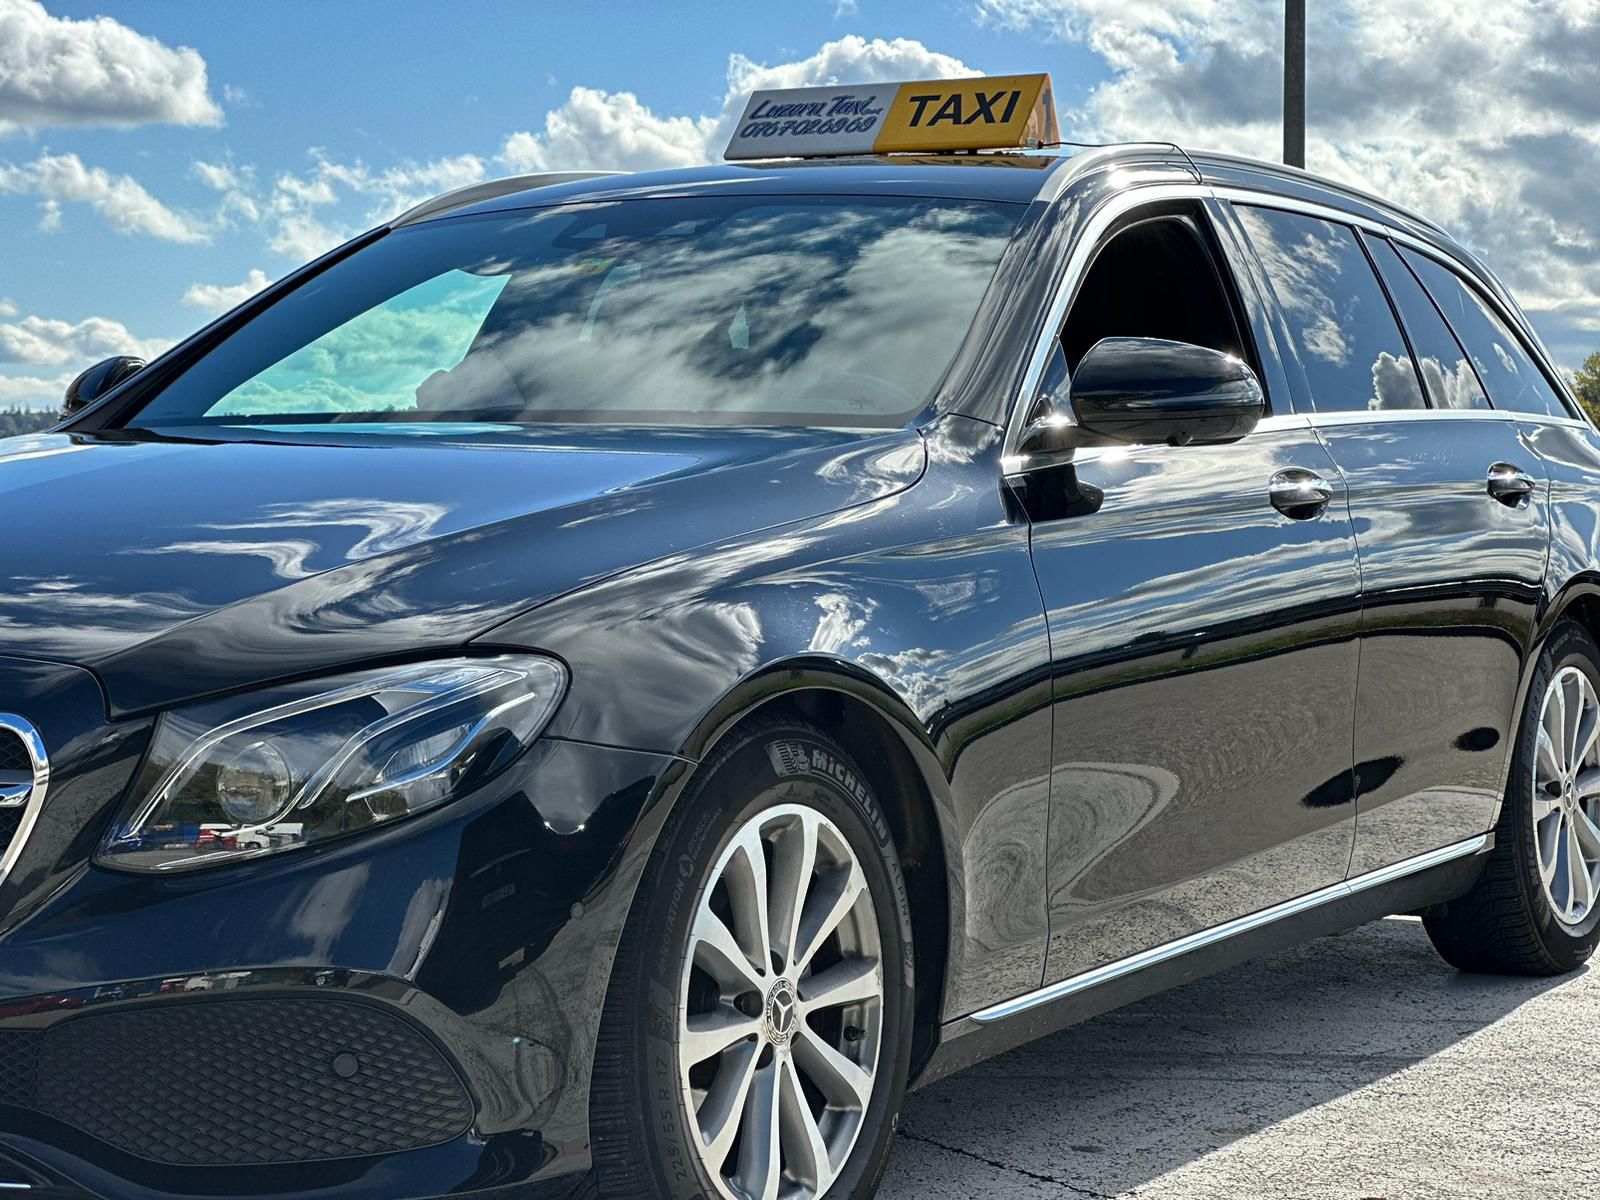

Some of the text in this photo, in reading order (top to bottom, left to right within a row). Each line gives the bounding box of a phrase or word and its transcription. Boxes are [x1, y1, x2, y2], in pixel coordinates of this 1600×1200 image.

[826, 95, 876, 117] Taxi
[909, 90, 1021, 127] TAXI
[812, 749, 888, 840] MICHELIN
[660, 879, 685, 957] ROTATION
[656, 1055, 689, 1182] 225/55 R 17
